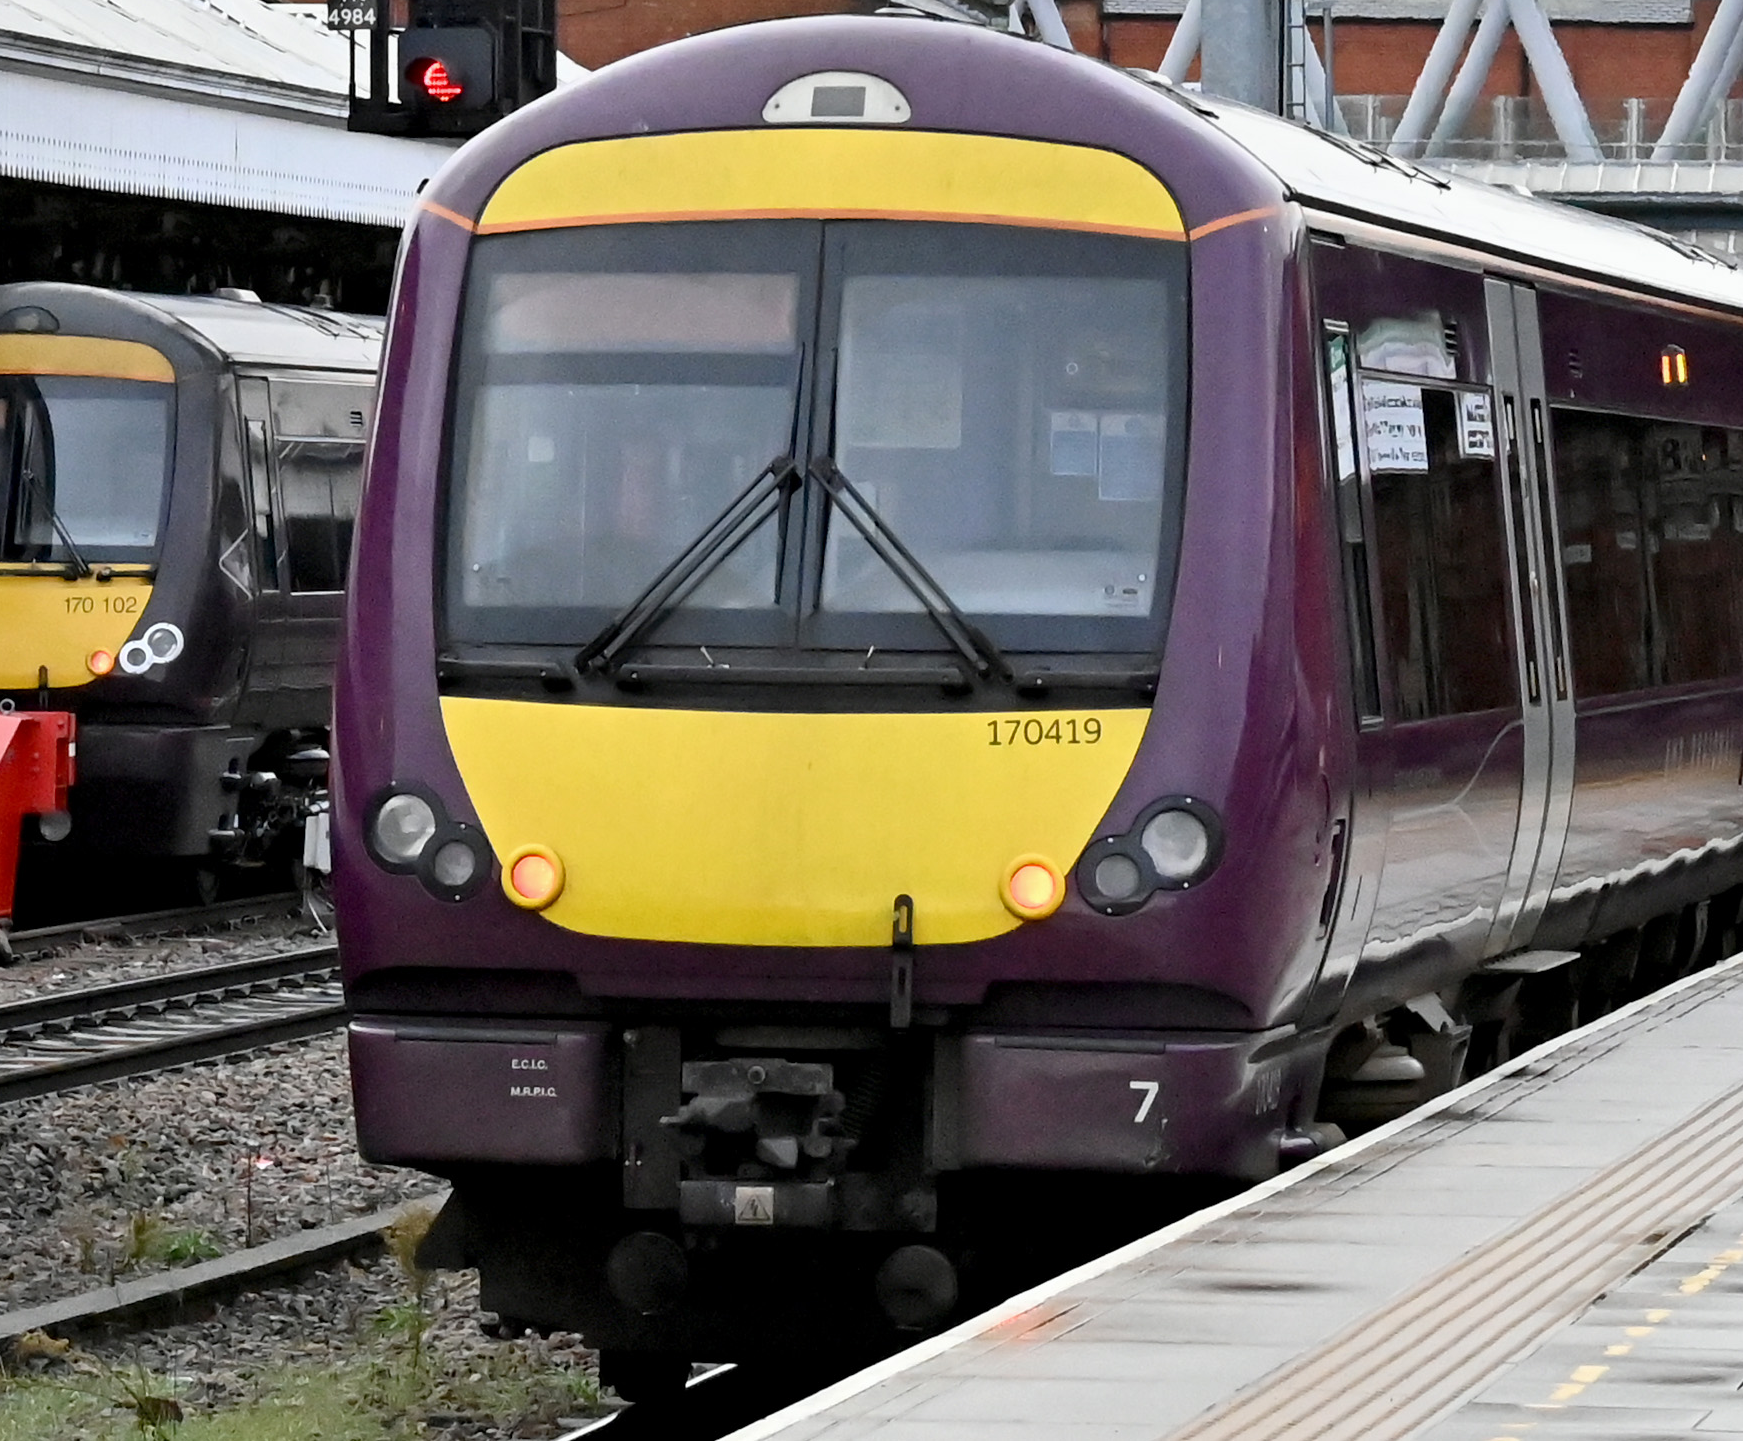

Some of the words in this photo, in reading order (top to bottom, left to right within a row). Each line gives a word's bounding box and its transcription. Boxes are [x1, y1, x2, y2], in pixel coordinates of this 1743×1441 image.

[328, 7, 376, 26] 4984
[64, 596, 95, 613] 170
[103, 596, 137, 613] 102
[986, 718, 1102, 746] 170419
[1129, 1081, 1159, 1123] 7
